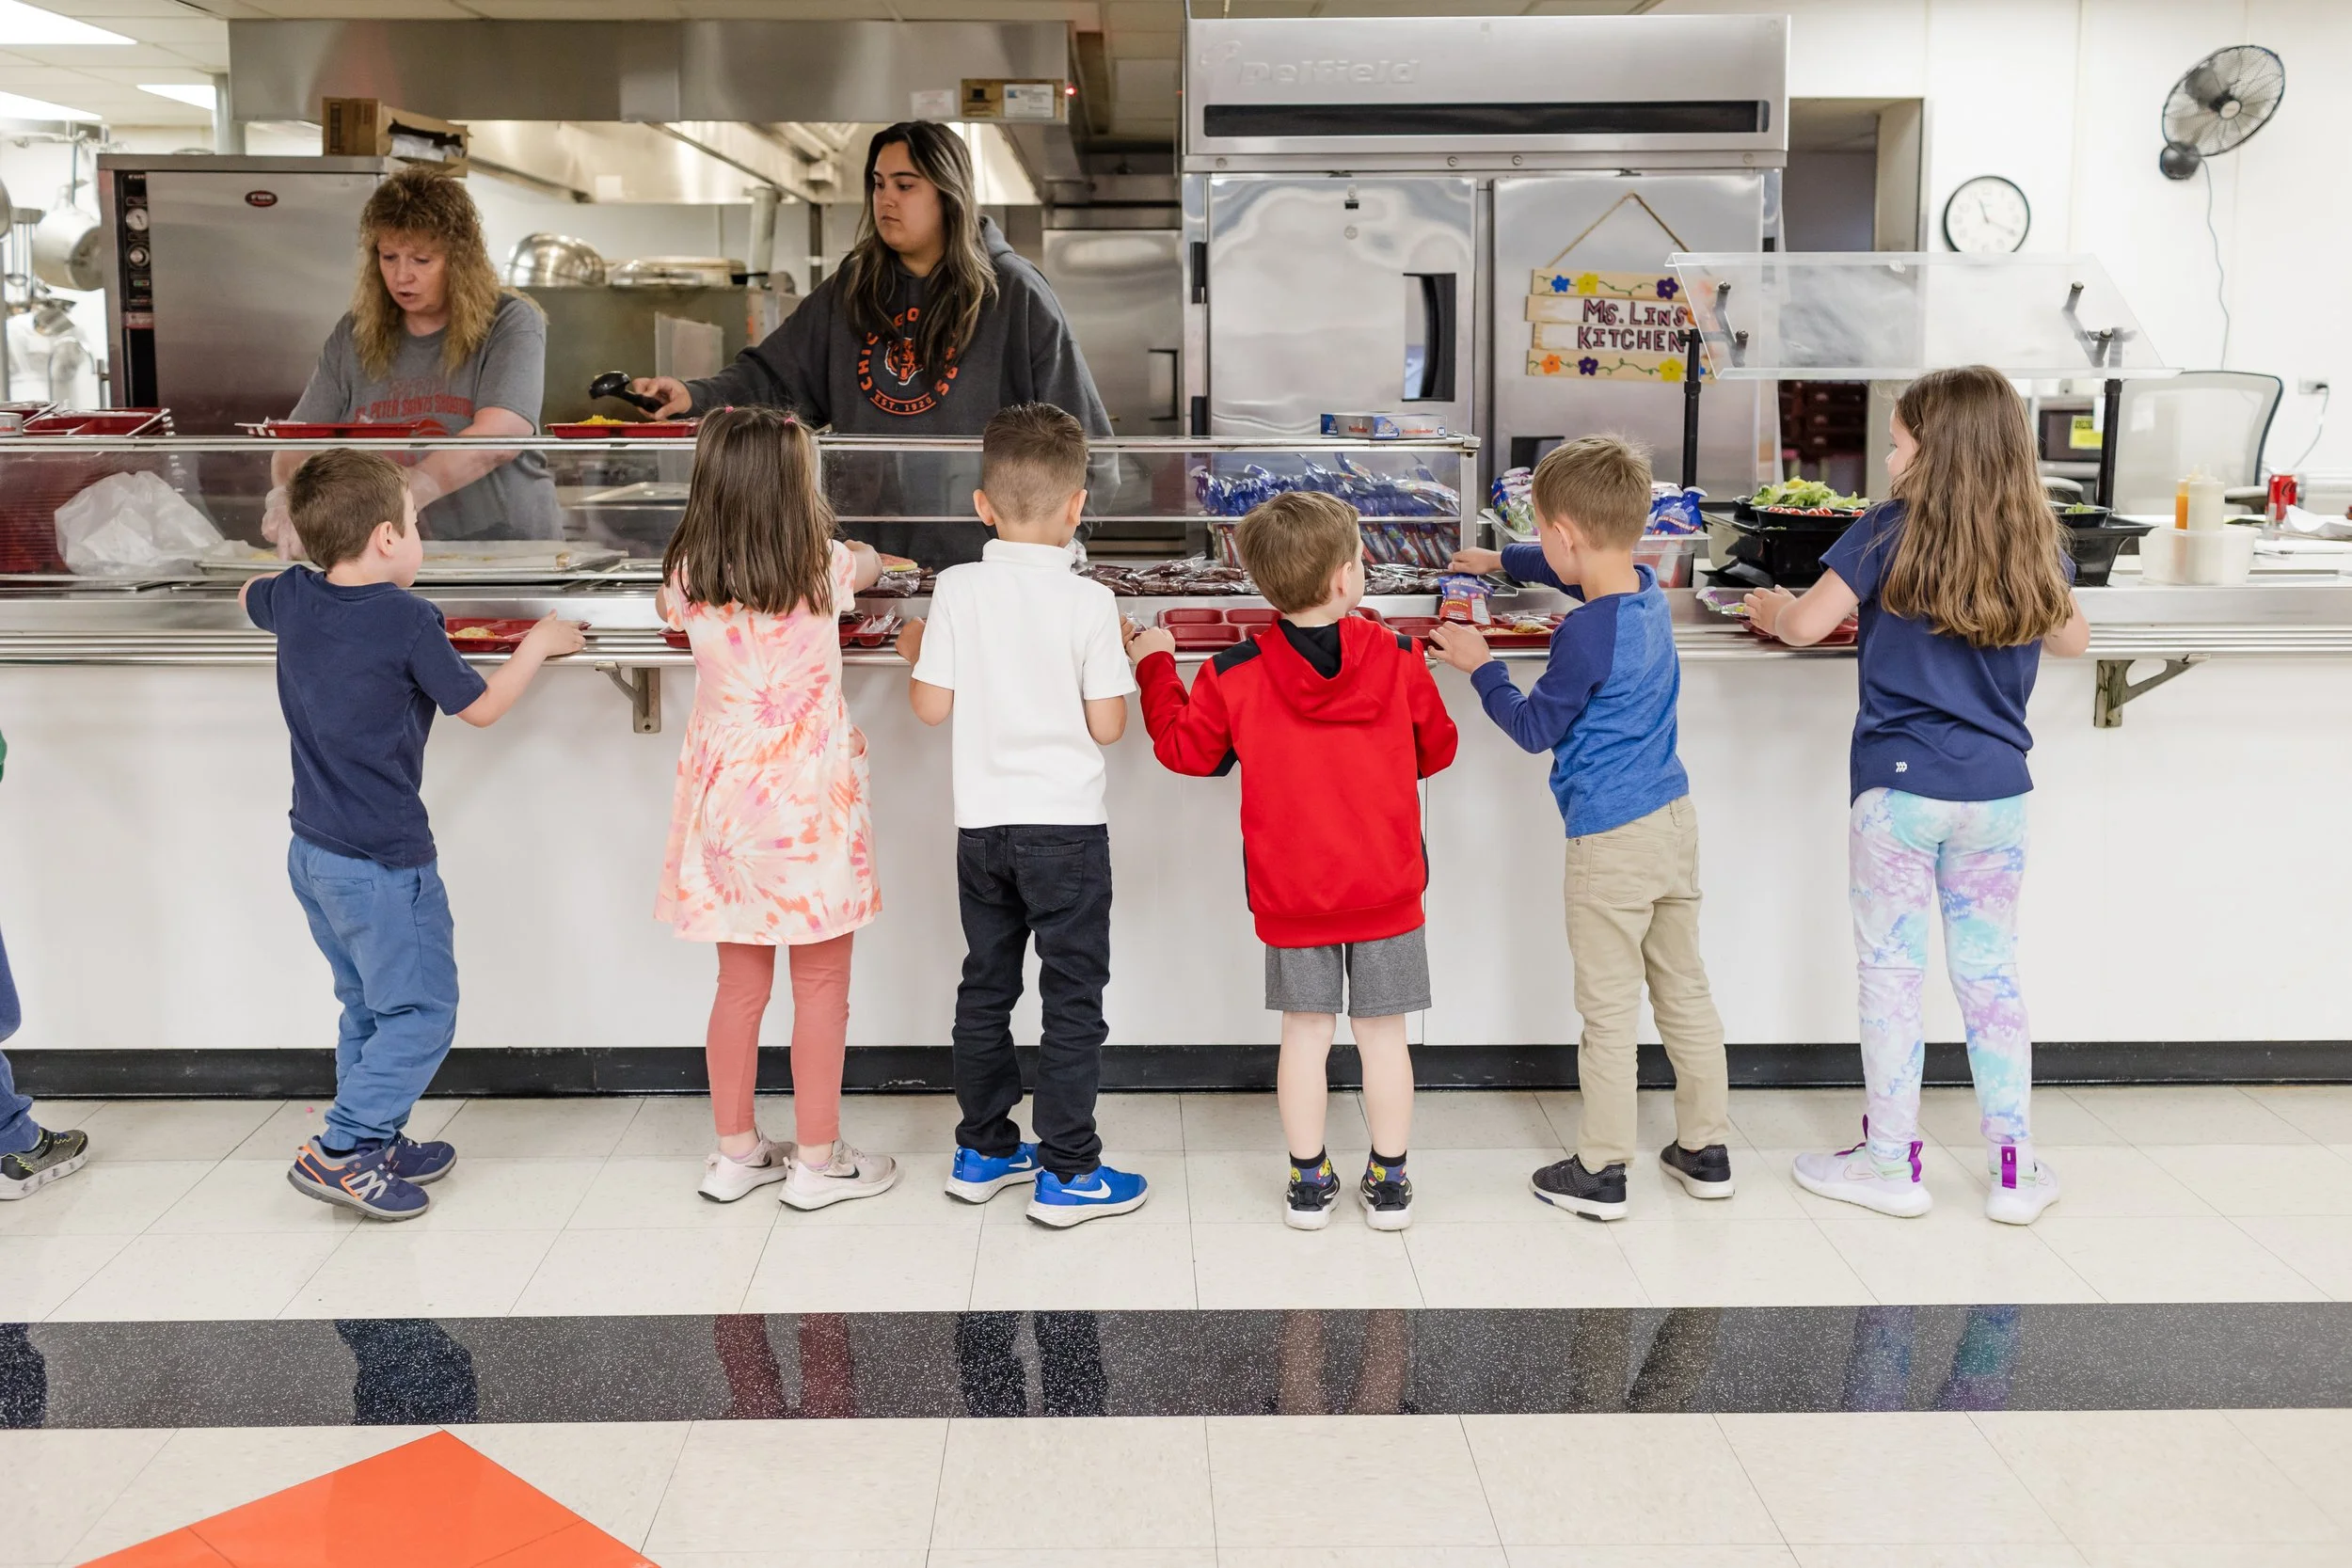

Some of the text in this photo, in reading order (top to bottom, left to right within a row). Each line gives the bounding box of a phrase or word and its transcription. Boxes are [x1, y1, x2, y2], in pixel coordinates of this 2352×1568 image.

[1236, 59, 1421, 87] Delfield
[1582, 299, 1625, 325] MS.
[857, 307, 920, 391] CHICGO
[1577, 325, 1685, 354] KITCHEN
[873, 394, 933, 412] EST. 1920
